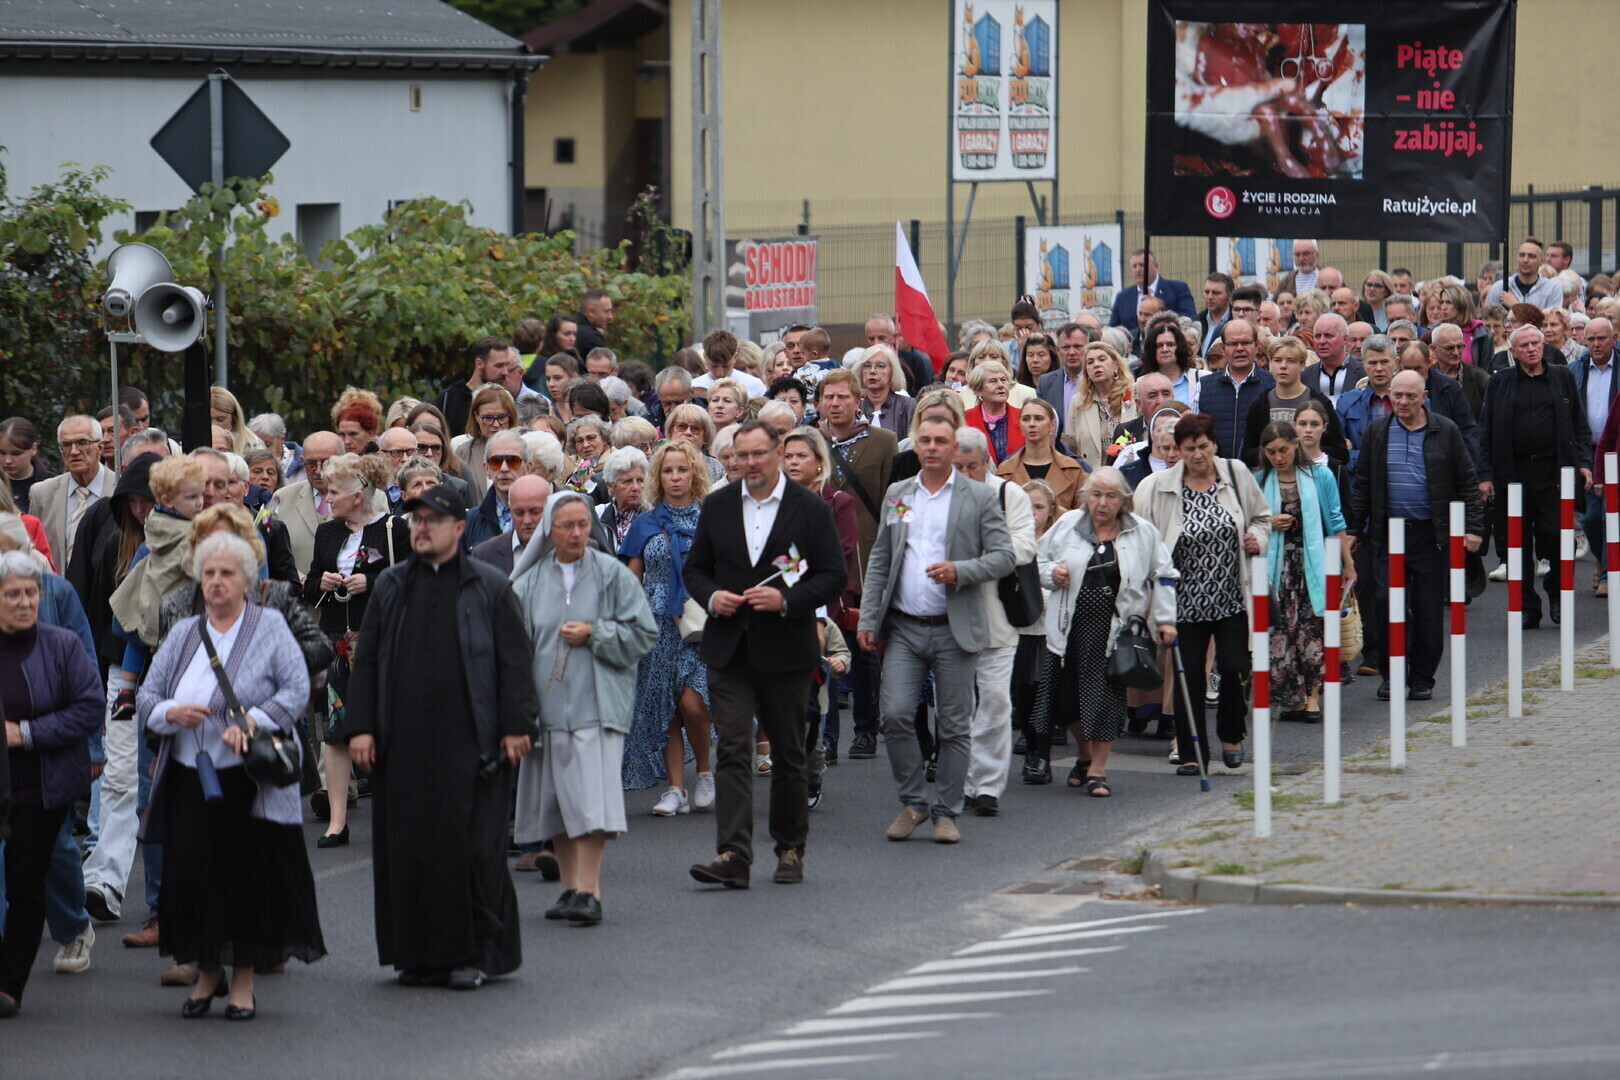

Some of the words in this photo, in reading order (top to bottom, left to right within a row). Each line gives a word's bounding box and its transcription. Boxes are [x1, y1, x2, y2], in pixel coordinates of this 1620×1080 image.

[1397, 41, 1463, 77] Piąte
[1416, 81, 1455, 110] nie
[966, 131, 998, 152] GARAŻY
[1016, 131, 1049, 152] GARAŻY
[1394, 122, 1483, 157] zabijaj.
[1242, 190, 1276, 204] ŻYCIE
[1283, 193, 1337, 205] RODZINA
[1383, 196, 1477, 217] RatujŻycie.pl
[1258, 206, 1321, 216] FUNDACJA
[745, 241, 817, 287] SCHODY
[744, 286, 816, 311] BALUSTRADY
